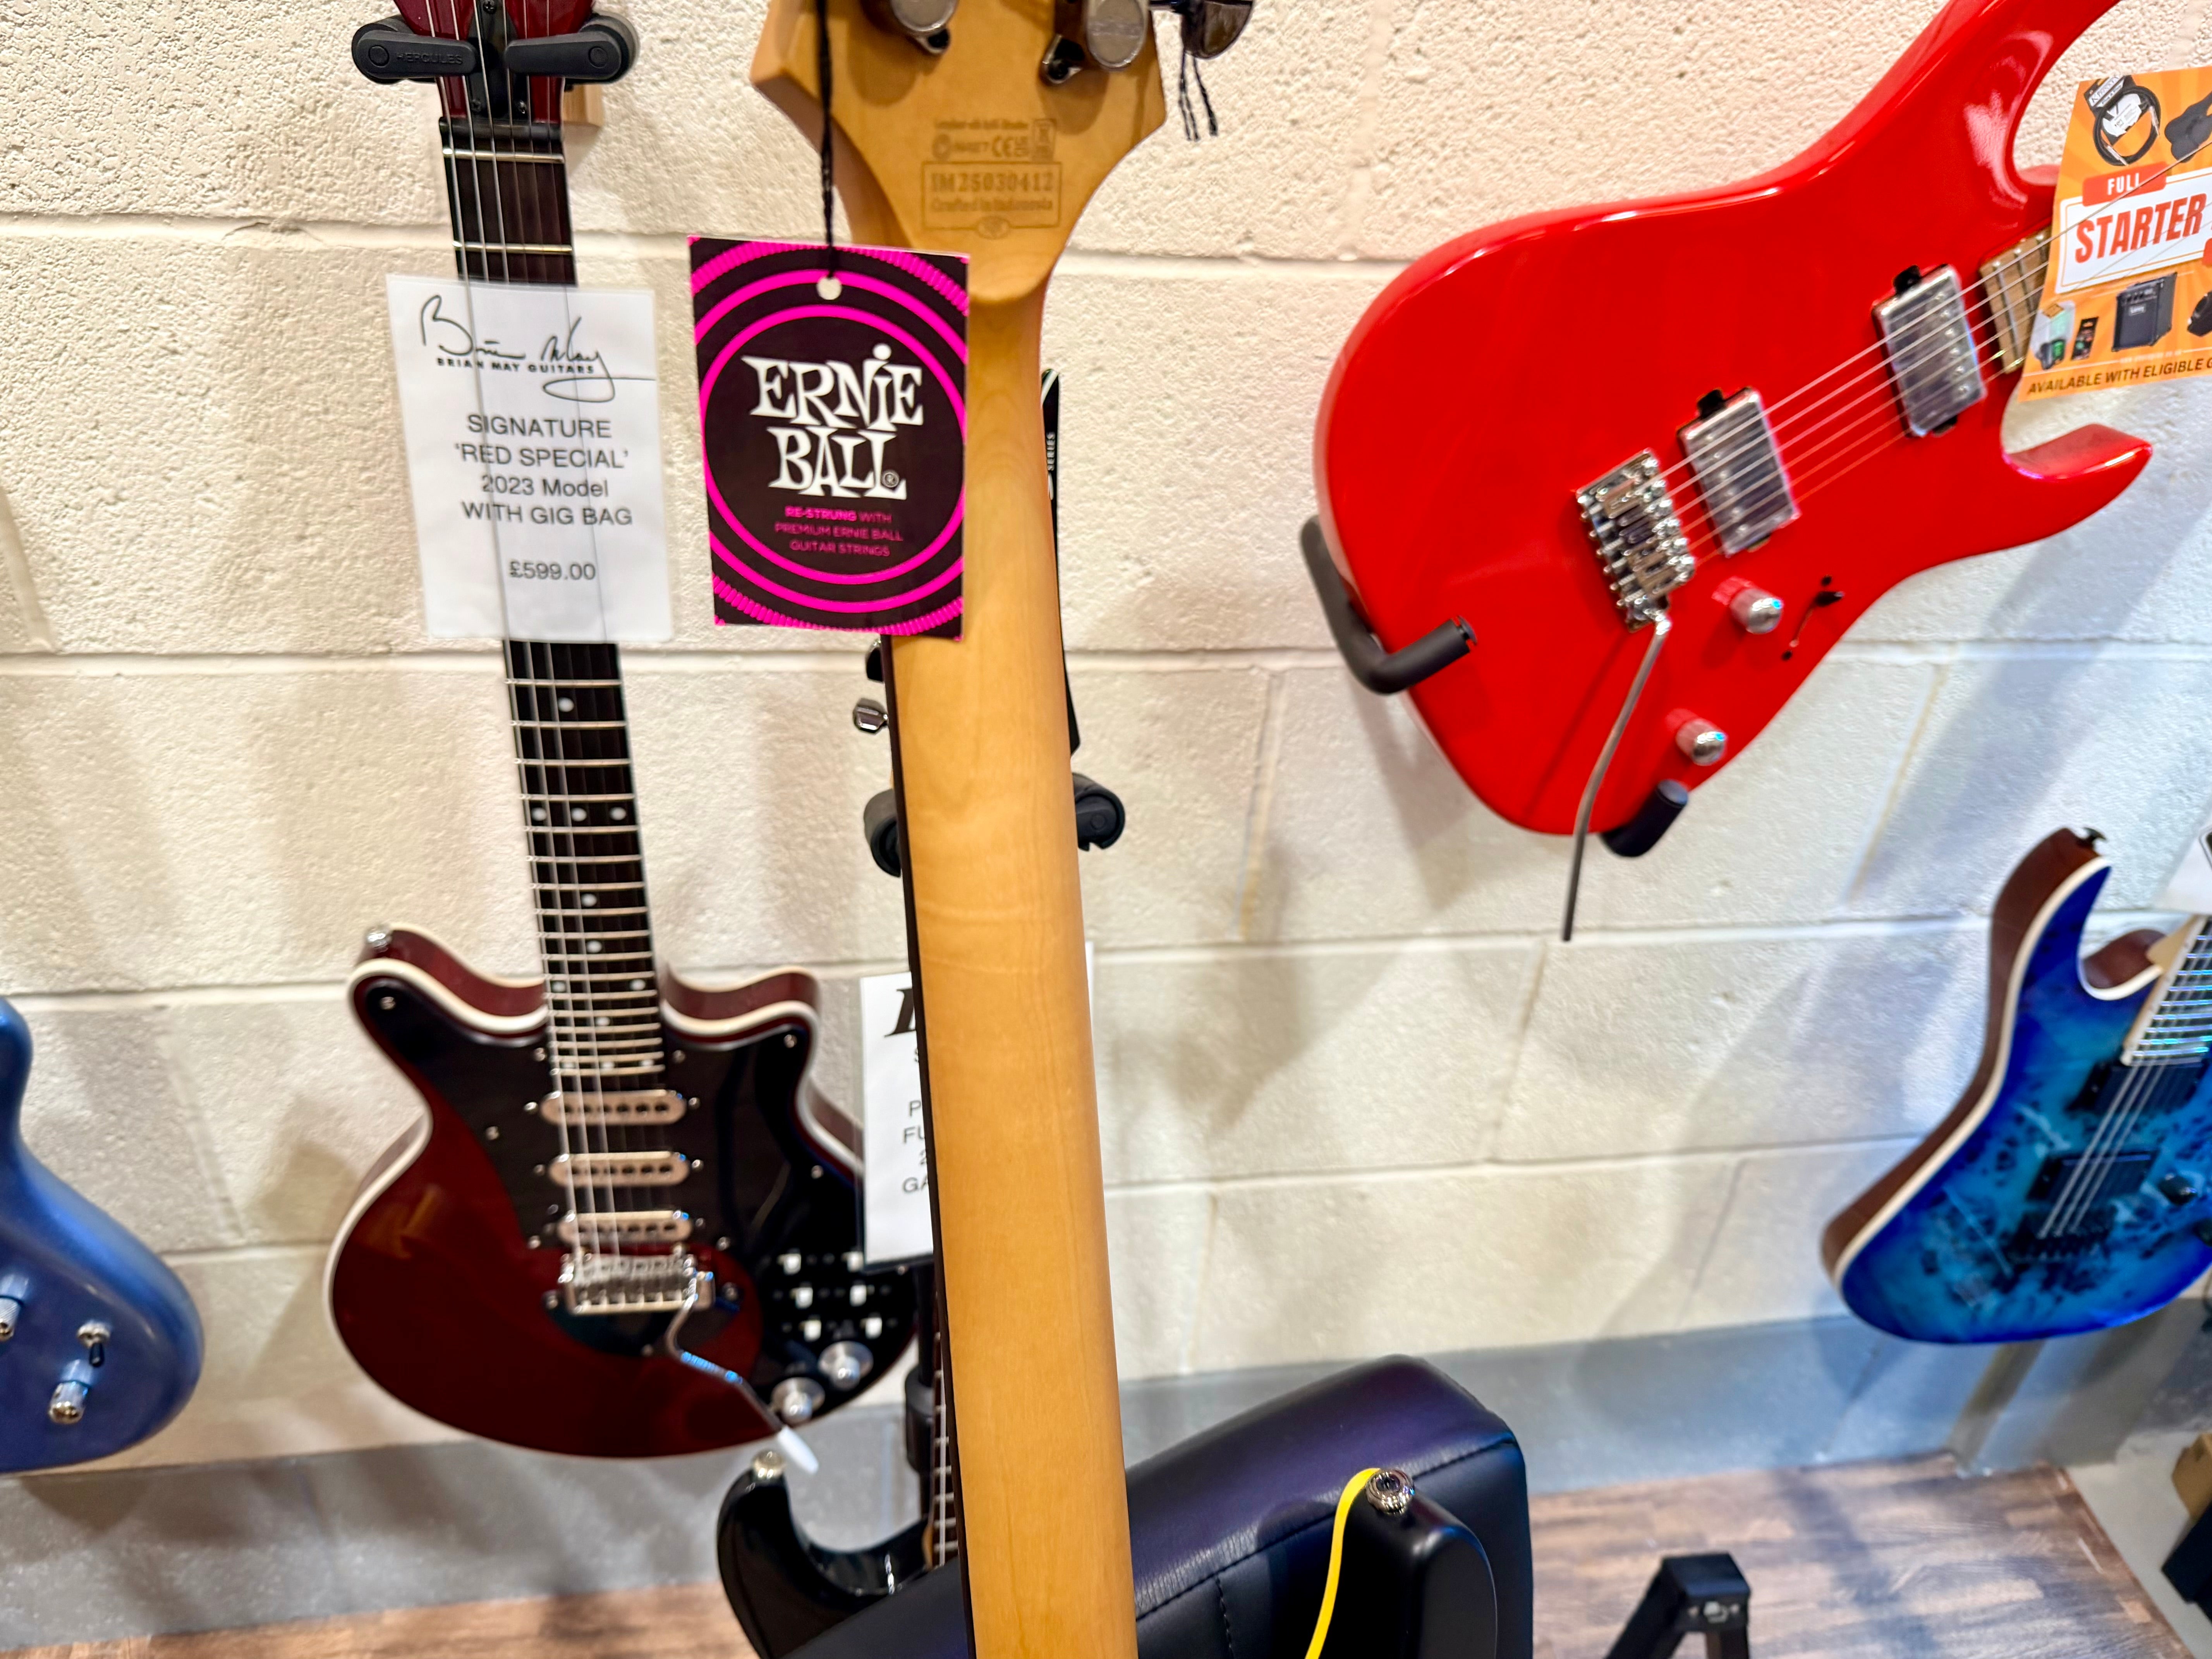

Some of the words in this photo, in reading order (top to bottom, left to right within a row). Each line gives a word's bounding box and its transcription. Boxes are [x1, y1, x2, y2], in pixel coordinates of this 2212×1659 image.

[2107, 173, 2139, 195] FULL
[2075, 193, 2207, 263] STARTER
[436, 357, 484, 369] BRIAN
[491, 362, 520, 372] MAY
[528, 364, 595, 374] GUITARS
[2027, 373, 2102, 394] AVAILABLE
[2105, 367, 2141, 383] WITH
[2143, 358, 2204, 379] ELIGIBLE
[741, 343, 924, 432] ERNIE
[467, 414, 612, 438] SIGNATURE
[481, 474, 534, 496] 2023
[542, 478, 609, 498] Model
[462, 501, 523, 522] WITH
[531, 507, 574, 525] GIG
[582, 507, 632, 526] BAG
[785, 506, 857, 522] RE-STRUNG
[859, 510, 892, 523] WITH
[775, 522, 831, 536] PREMIUM
[833, 526, 869, 539] ERNIE
[871, 528, 903, 541] BALL
[790, 539, 836, 553] GUITAR
[838, 543, 890, 557] STRINGS
[509, 561, 596, 580] £599.00
